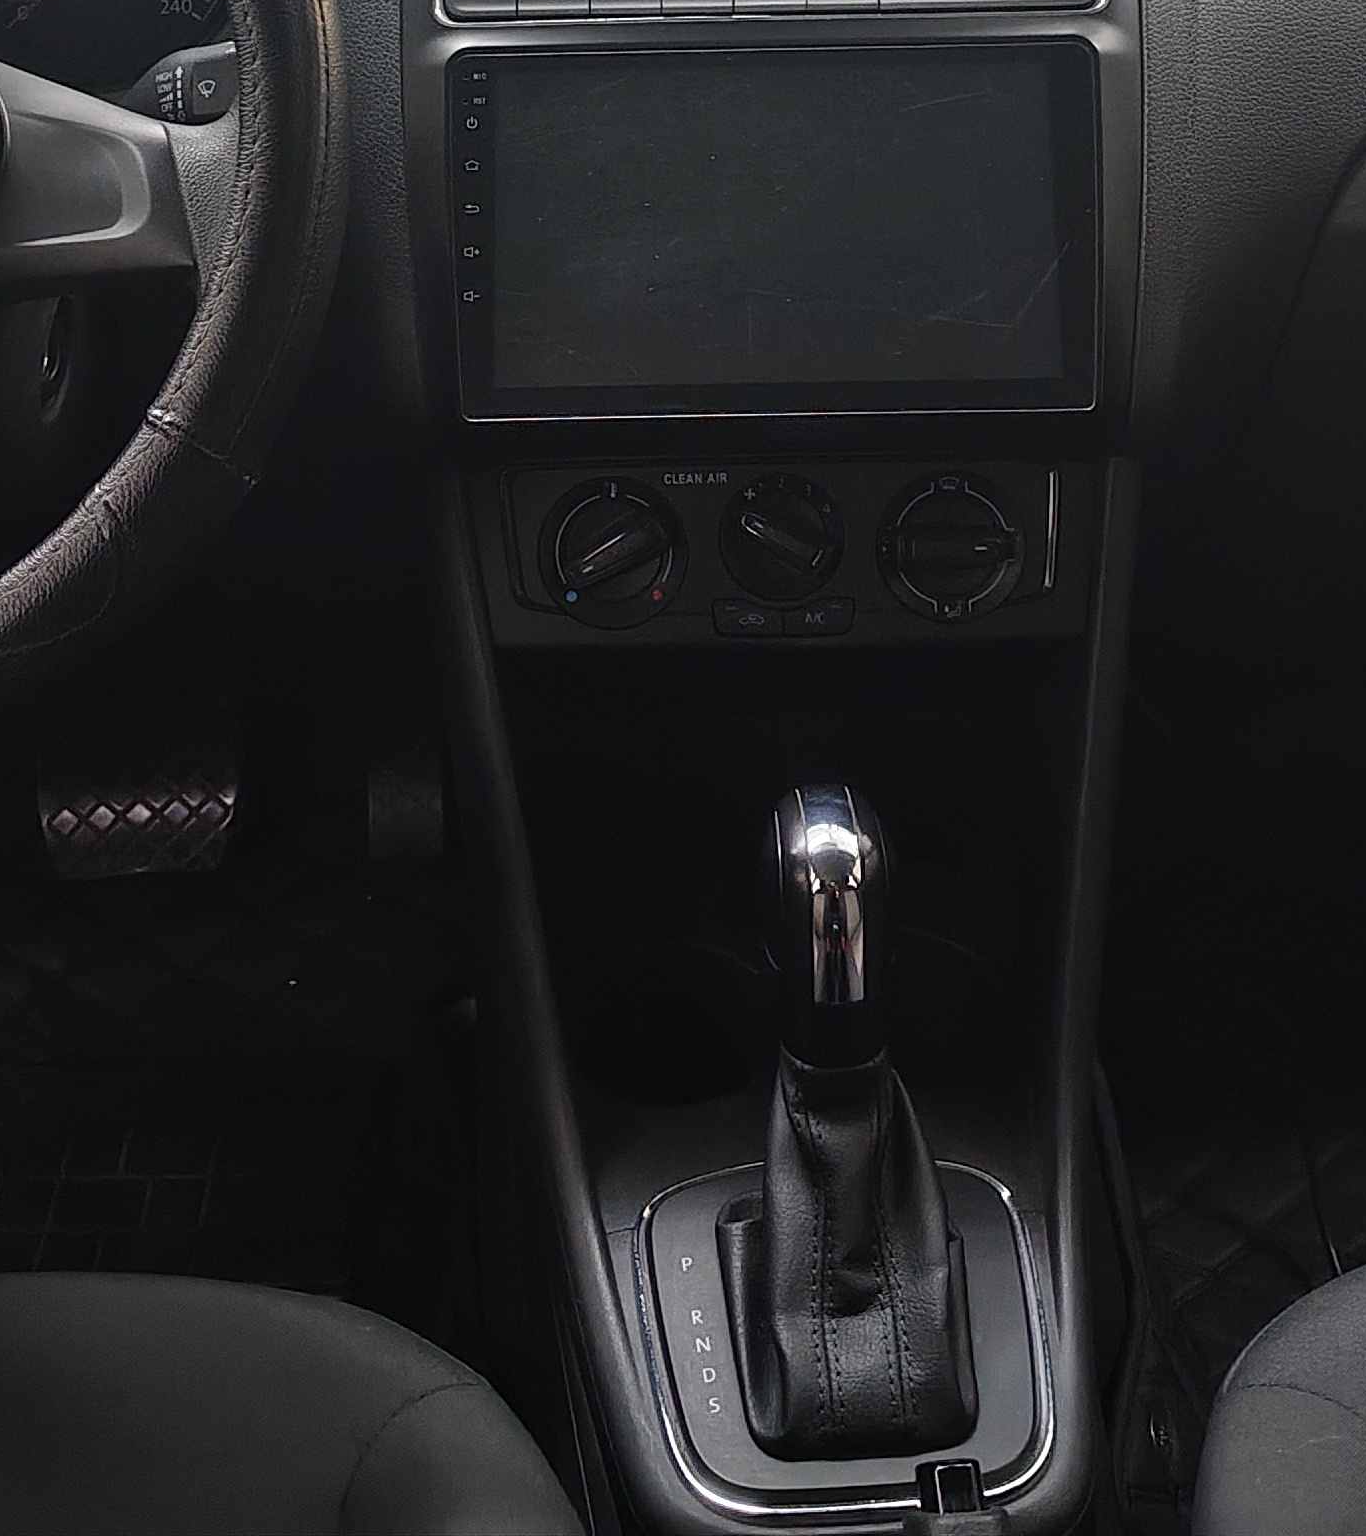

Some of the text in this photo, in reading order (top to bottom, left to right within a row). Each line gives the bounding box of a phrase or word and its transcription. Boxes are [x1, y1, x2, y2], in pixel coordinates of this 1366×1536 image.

[160, 0, 193, 15] 240
[664, 472, 728, 486] CLEAN AIR
[681, 1257, 695, 1272] P
[691, 1309, 704, 1325] R
[695, 1336, 711, 1353] N
[703, 1367, 717, 1383] D
[708, 1397, 721, 1414] S
